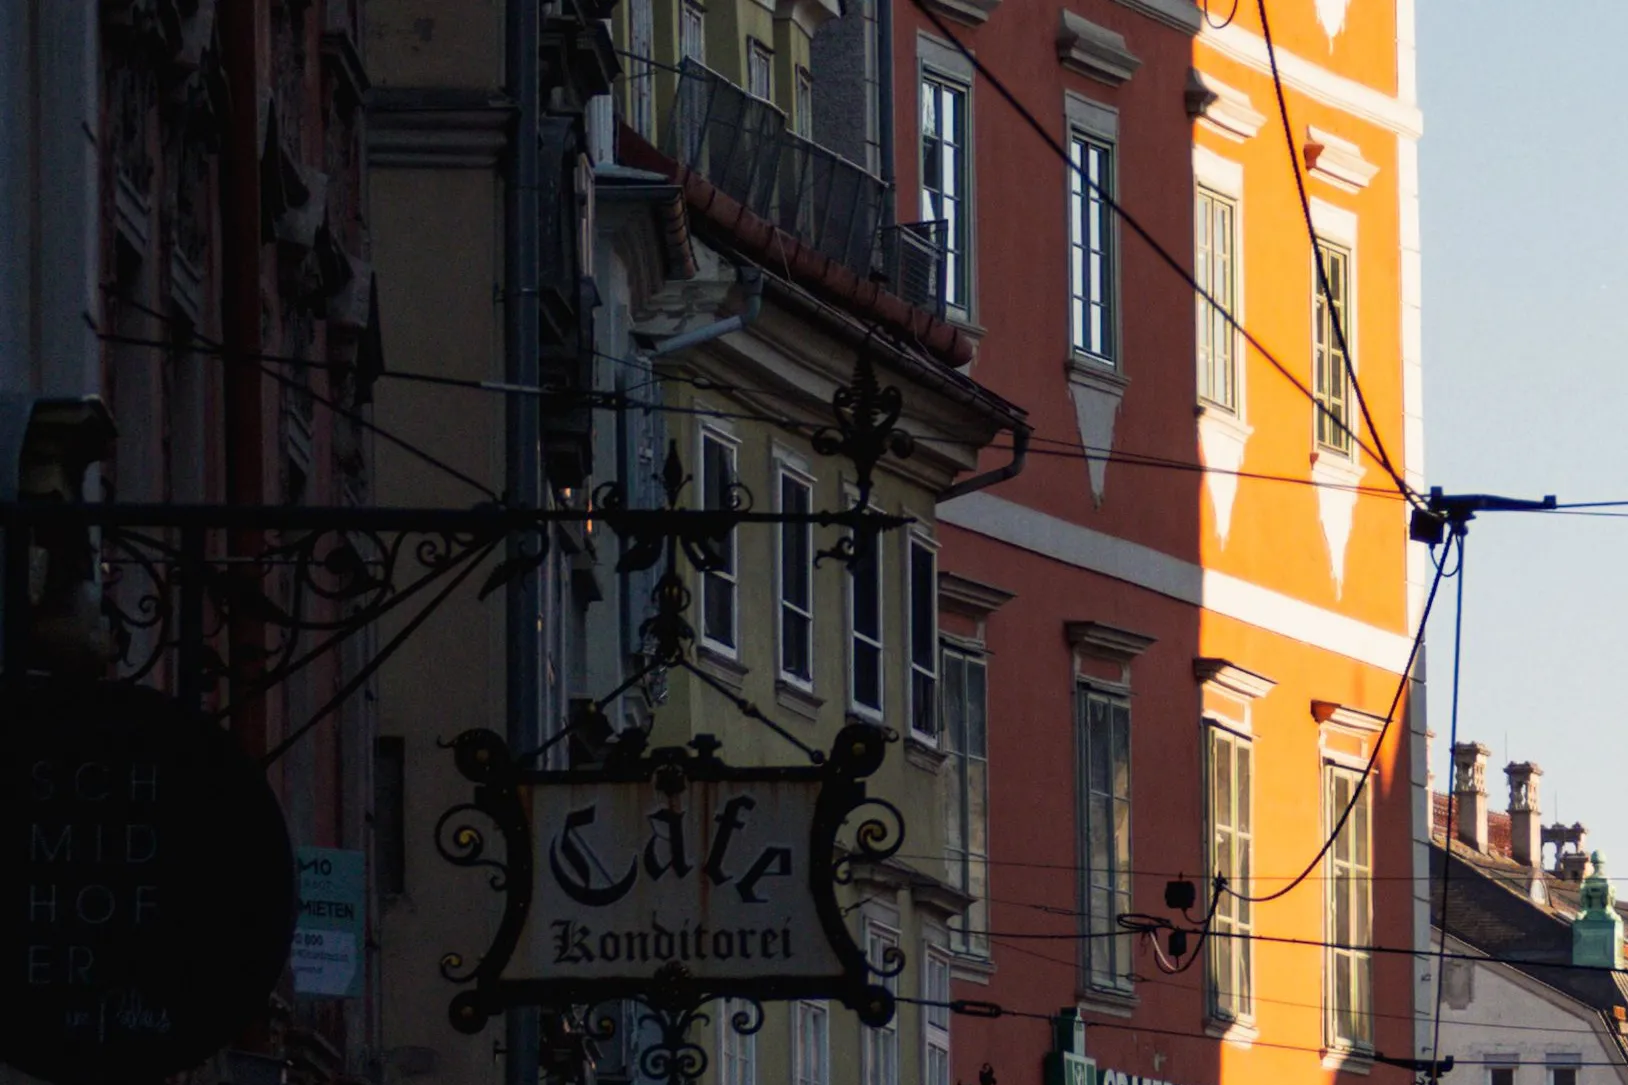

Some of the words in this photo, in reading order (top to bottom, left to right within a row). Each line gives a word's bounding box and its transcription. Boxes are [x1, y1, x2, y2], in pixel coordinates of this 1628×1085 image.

[31, 760, 157, 801] SCH
[31, 822, 158, 863] MID
[30, 884, 158, 924] HOF
[551, 910, 795, 964] Konditorei
[29, 944, 95, 984] ER
